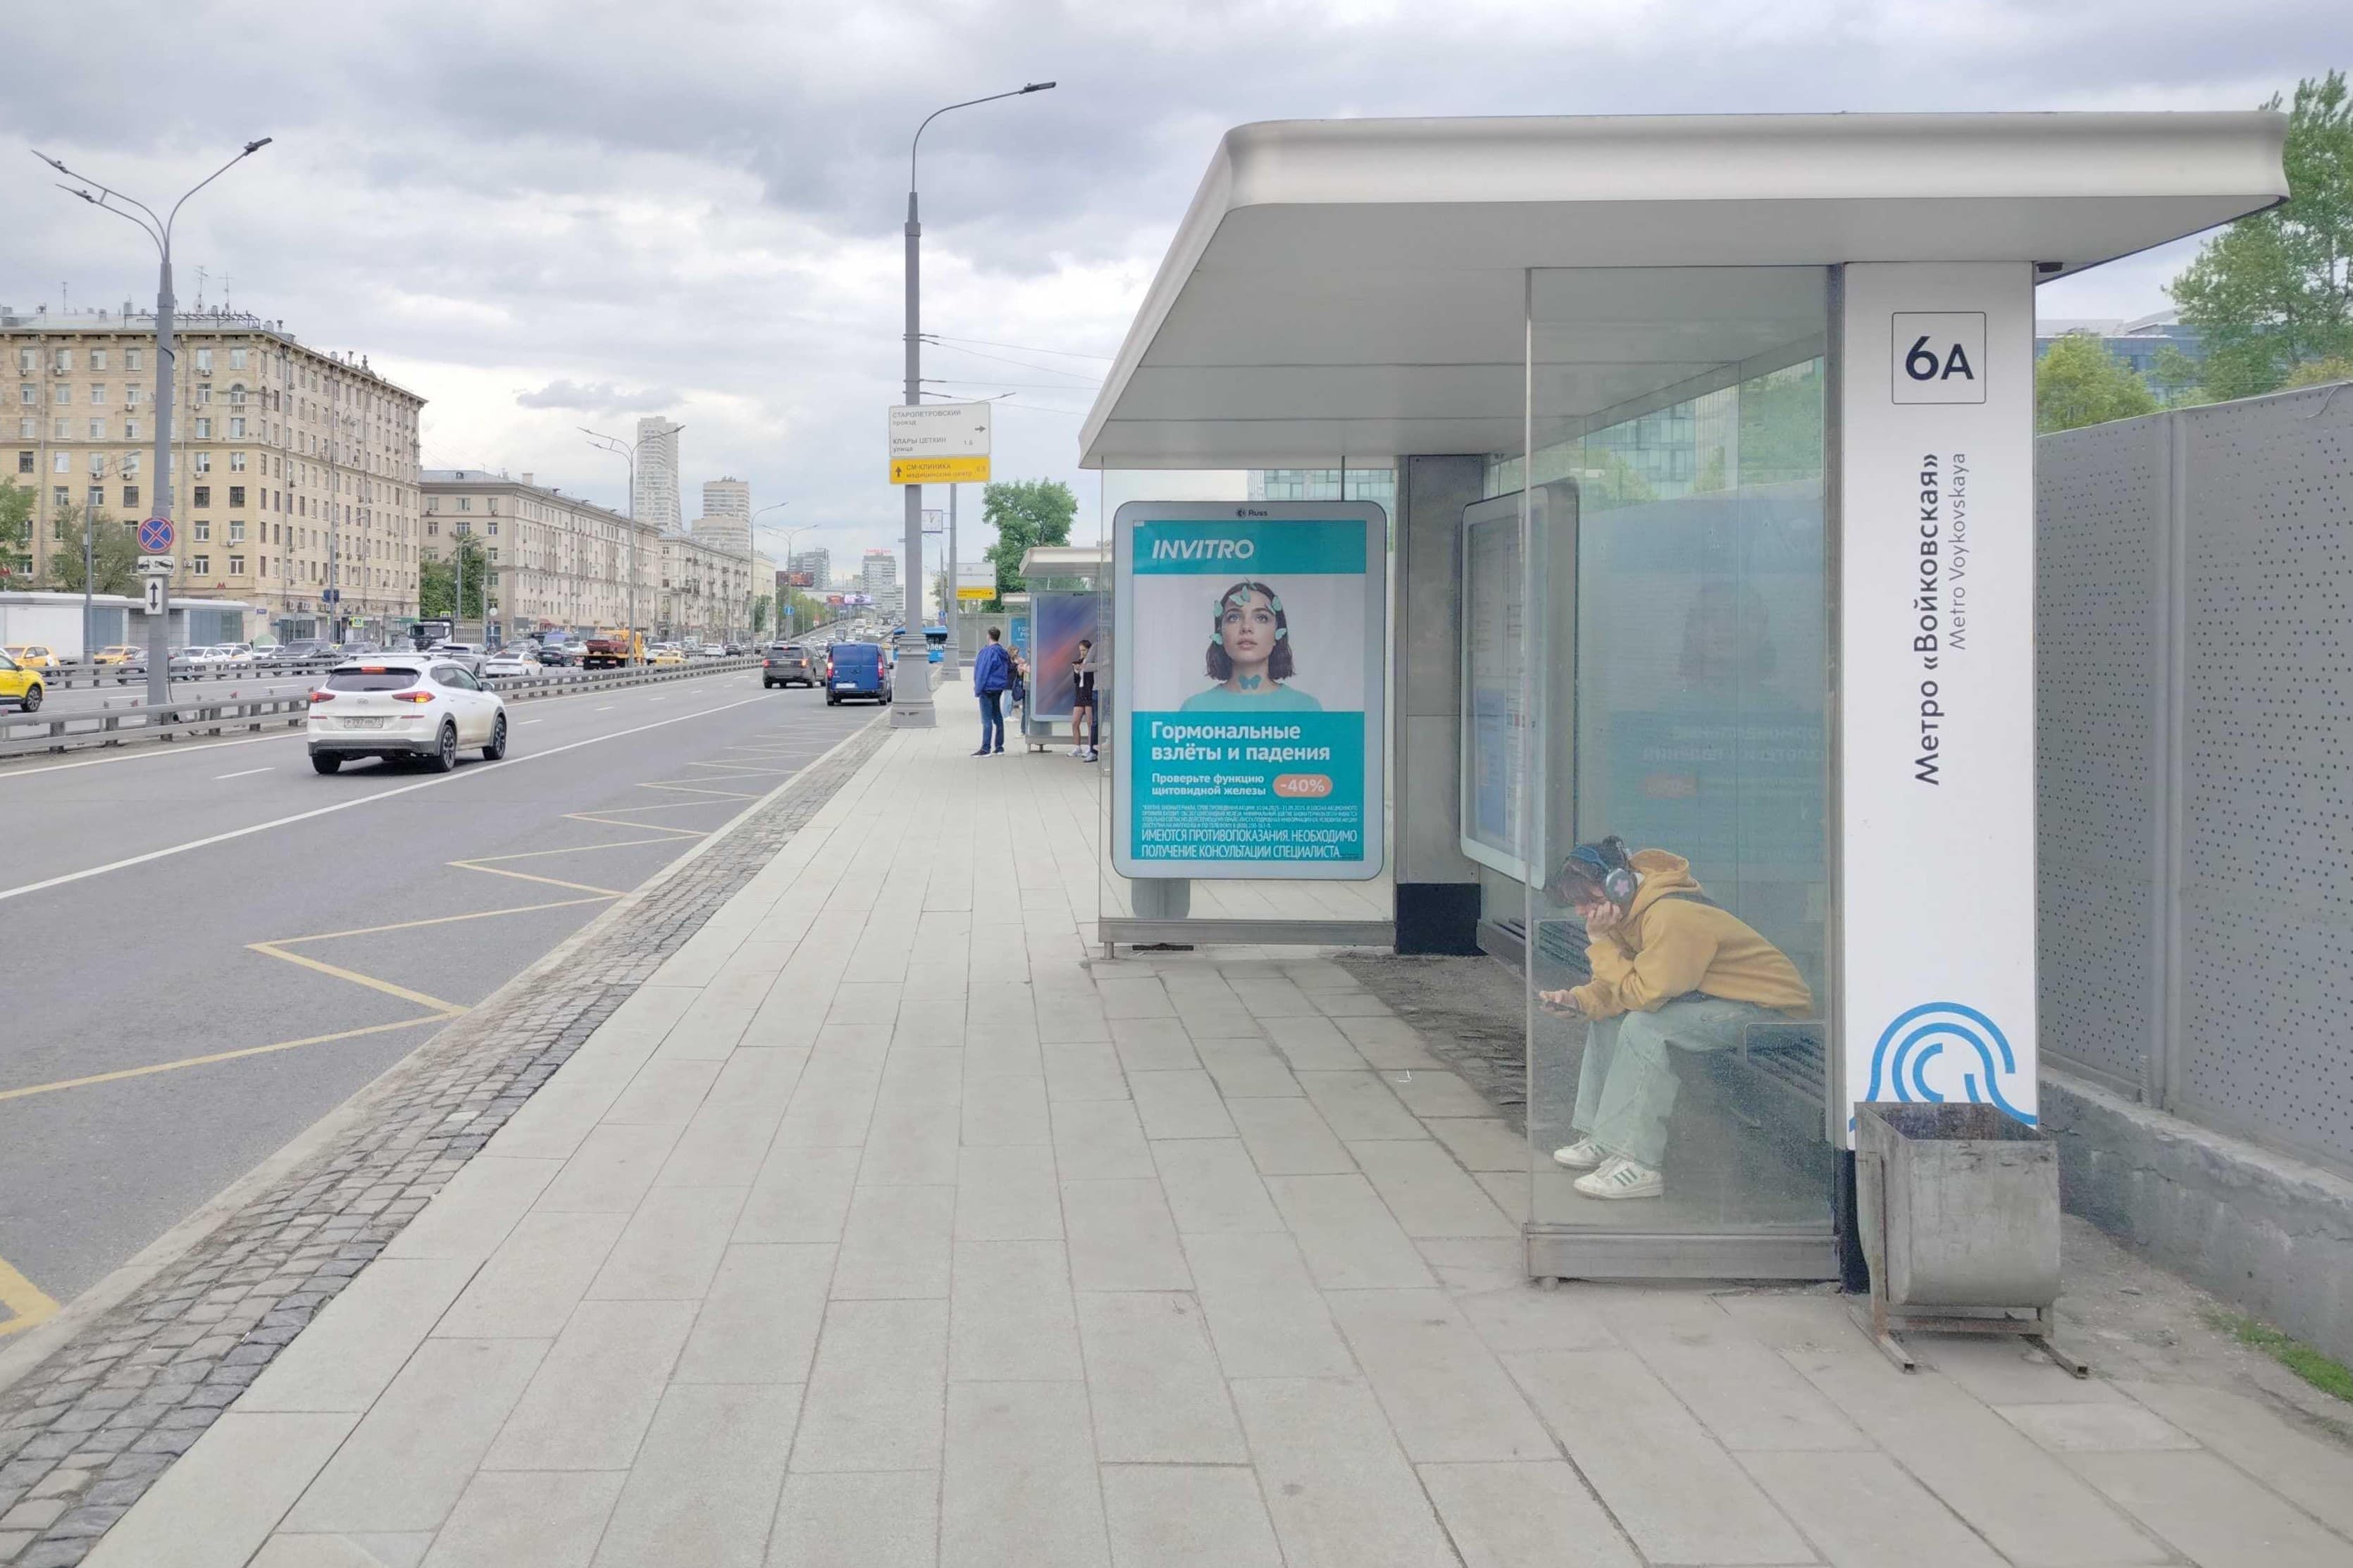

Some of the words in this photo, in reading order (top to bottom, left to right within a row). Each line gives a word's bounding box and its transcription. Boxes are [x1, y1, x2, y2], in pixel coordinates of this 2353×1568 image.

[1248, 509, 1268, 517] Russ
[1947, 453, 1970, 581] Voykovskaya
[1152, 539, 1255, 559] INVITRO
[1913, 453, 1939, 671] «Войковская»
[1949, 587, 1966, 650] Metro
[1151, 721, 1301, 742] Гормональные
[1914, 680, 1944, 786] Метро
[1152, 743, 1221, 761] взлёты
[1228, 747, 1240, 760] и
[1246, 747, 1330, 763] падения
[1152, 773, 1211, 785] Проверьте
[1213, 773, 1265, 785] функцию
[1279, 779, 1326, 793] -40%
[1152, 785, 1221, 796] щитовидной
[1223, 786, 1267, 796] железы
[1142, 829, 1187, 842] ИМЕЮТСЯ
[1188, 829, 1291, 842] ПРОТИВОПОКАЗАНИЯ.
[1291, 830, 1358, 844] НЕОБХОДИМО
[1141, 845, 1197, 858] ПОЛУЧЕНИЕ
[1199, 845, 1271, 859] КОНСУЛЬТАЦИИ
